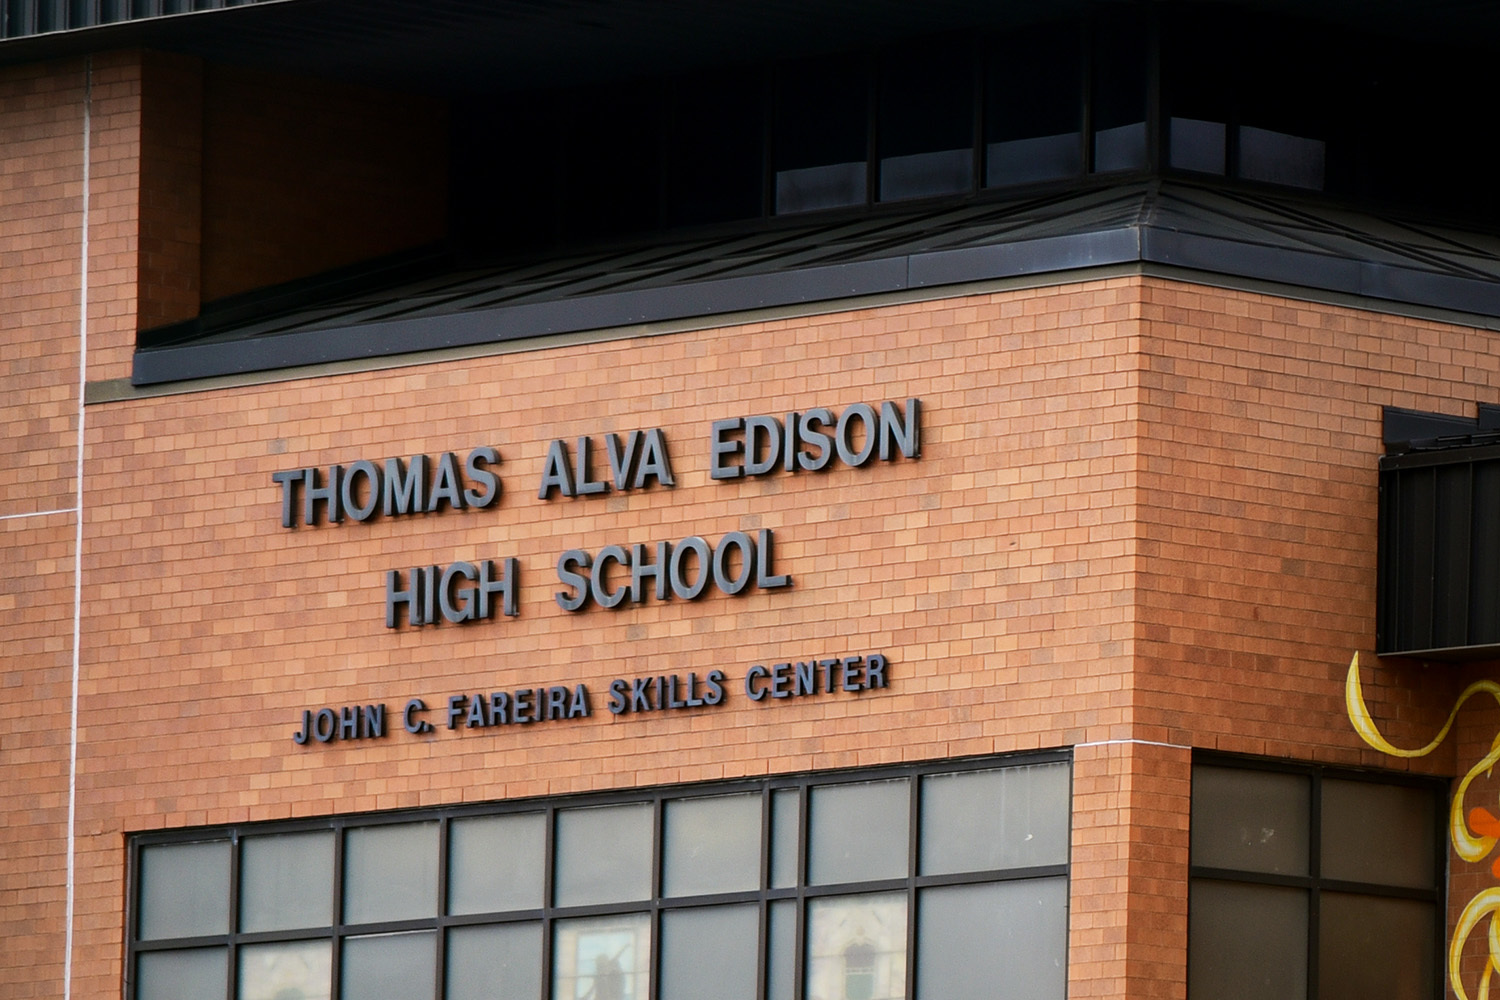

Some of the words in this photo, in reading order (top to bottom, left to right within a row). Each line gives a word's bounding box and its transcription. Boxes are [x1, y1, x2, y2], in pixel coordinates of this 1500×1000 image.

[273, 447, 501, 529] THOMAS
[538, 428, 677, 499] ALVA
[710, 398, 922, 481] EDISON
[386, 557, 520, 628] HIGH
[554, 528, 796, 613] SCHOOL
[293, 703, 387, 745] JOHN
[403, 699, 434, 734] C.
[447, 684, 592, 730] FAREIRA
[607, 669, 726, 715] SKILLS
[745, 654, 889, 701] CENTER
